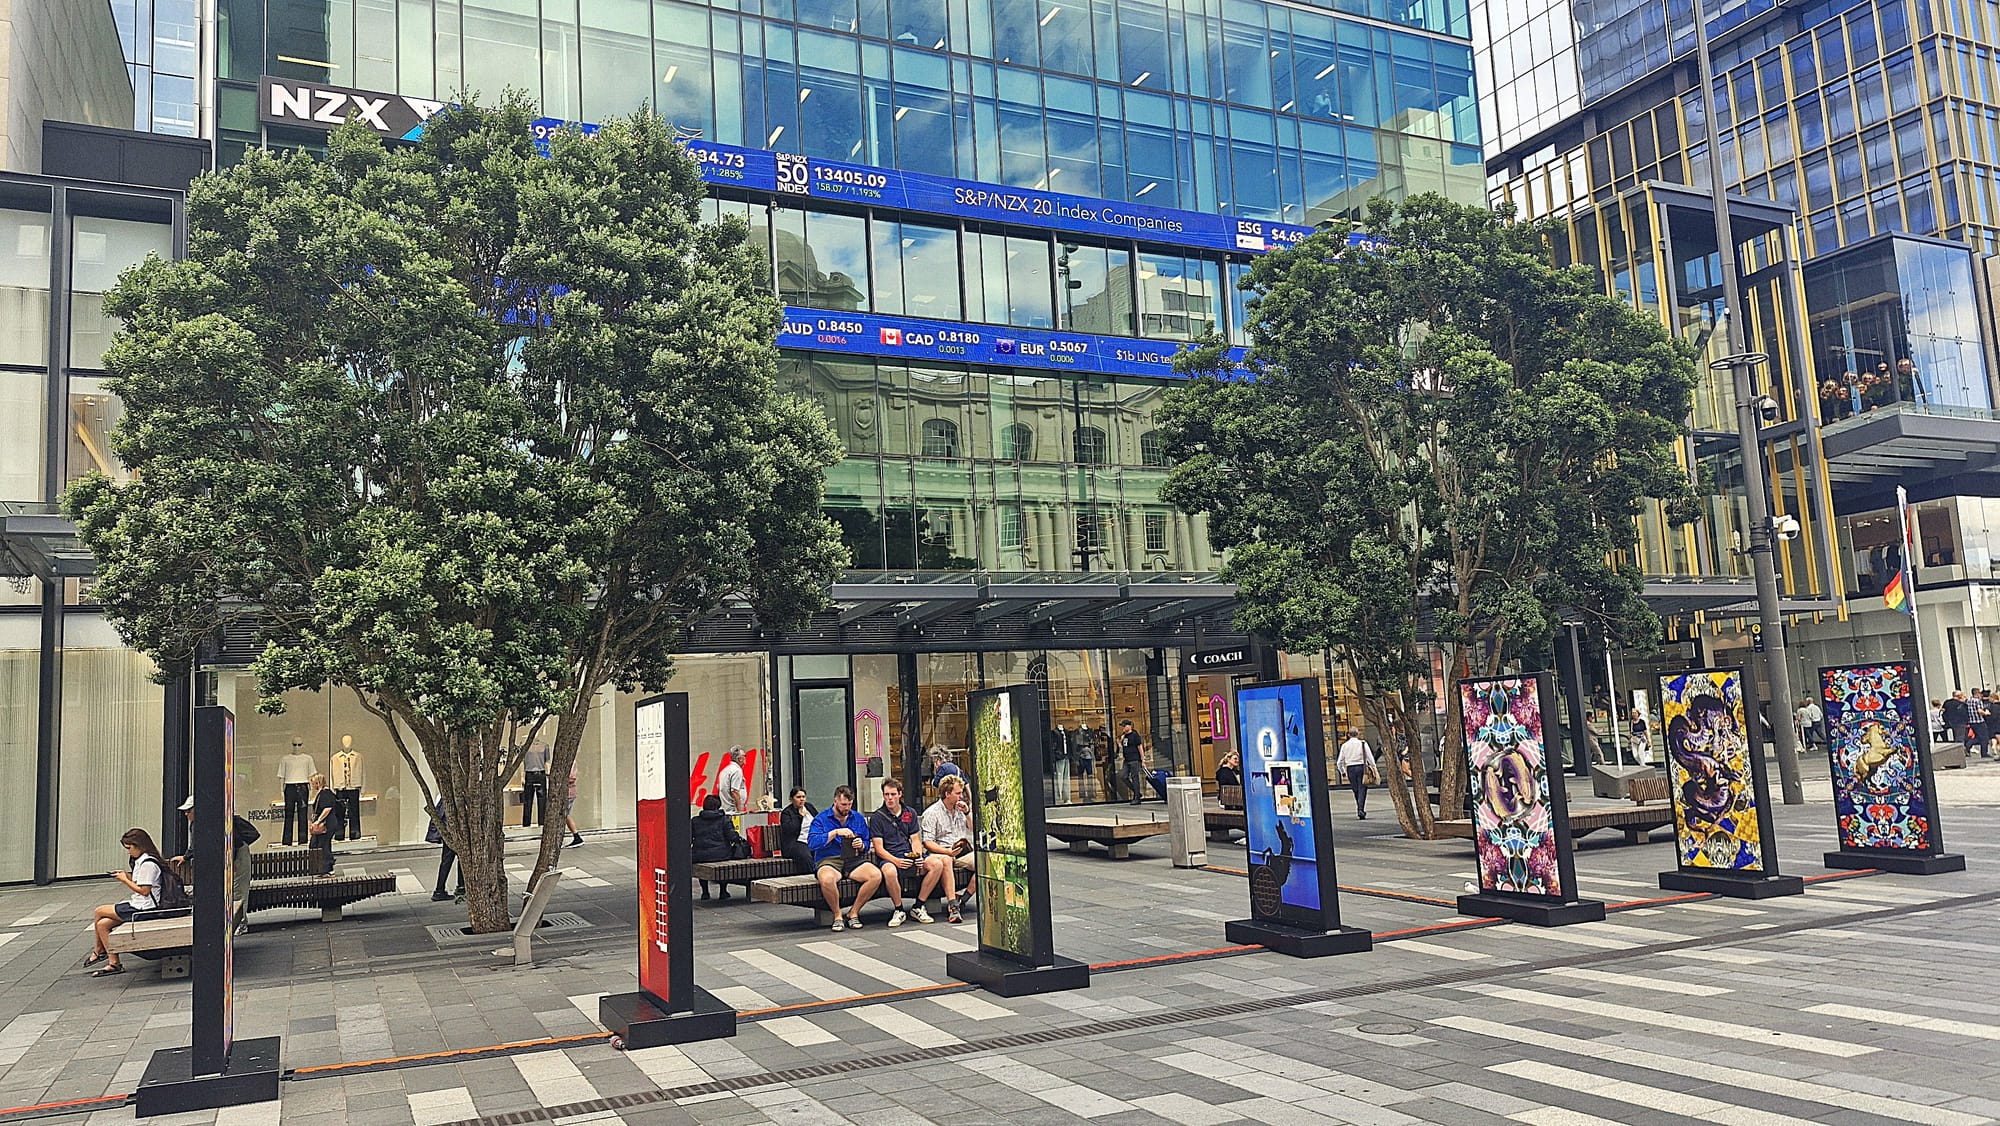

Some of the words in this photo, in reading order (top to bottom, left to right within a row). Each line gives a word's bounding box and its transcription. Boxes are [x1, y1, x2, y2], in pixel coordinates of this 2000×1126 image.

[271, 83, 392, 132] NZX
[711, 167, 744, 180] 1.285%
[777, 161, 808, 185] 50
[814, 166, 887, 188] 13405.09
[777, 182, 809, 195] INDEX
[816, 182, 843, 194] 158.07
[852, 187, 881, 199] 1.193%
[954, 187, 1029, 213] S&P/NZX
[1033, 198, 1052, 215] 20
[1057, 201, 1098, 221] Index
[1102, 208, 1183, 232] Companies
[1237, 221, 1262, 235] ESG
[1271, 228, 1304, 243] $4.63
[782, 322, 813, 336] AUD
[817, 319, 863, 334] 0.8450
[817, 335, 847, 345] 0.0016
[905, 333, 934, 346] CAD
[938, 330, 980, 344] 0.8180
[938, 345, 965, 355] 0.0013
[1020, 343, 1045, 355] EUR
[1050, 340, 1088, 353] 0.5067
[1050, 354, 1075, 364] 0.0006
[1116, 349, 1135, 361] $1b
[1137, 351, 1158, 363] LNG
[1203, 651, 1243, 665] COACH
